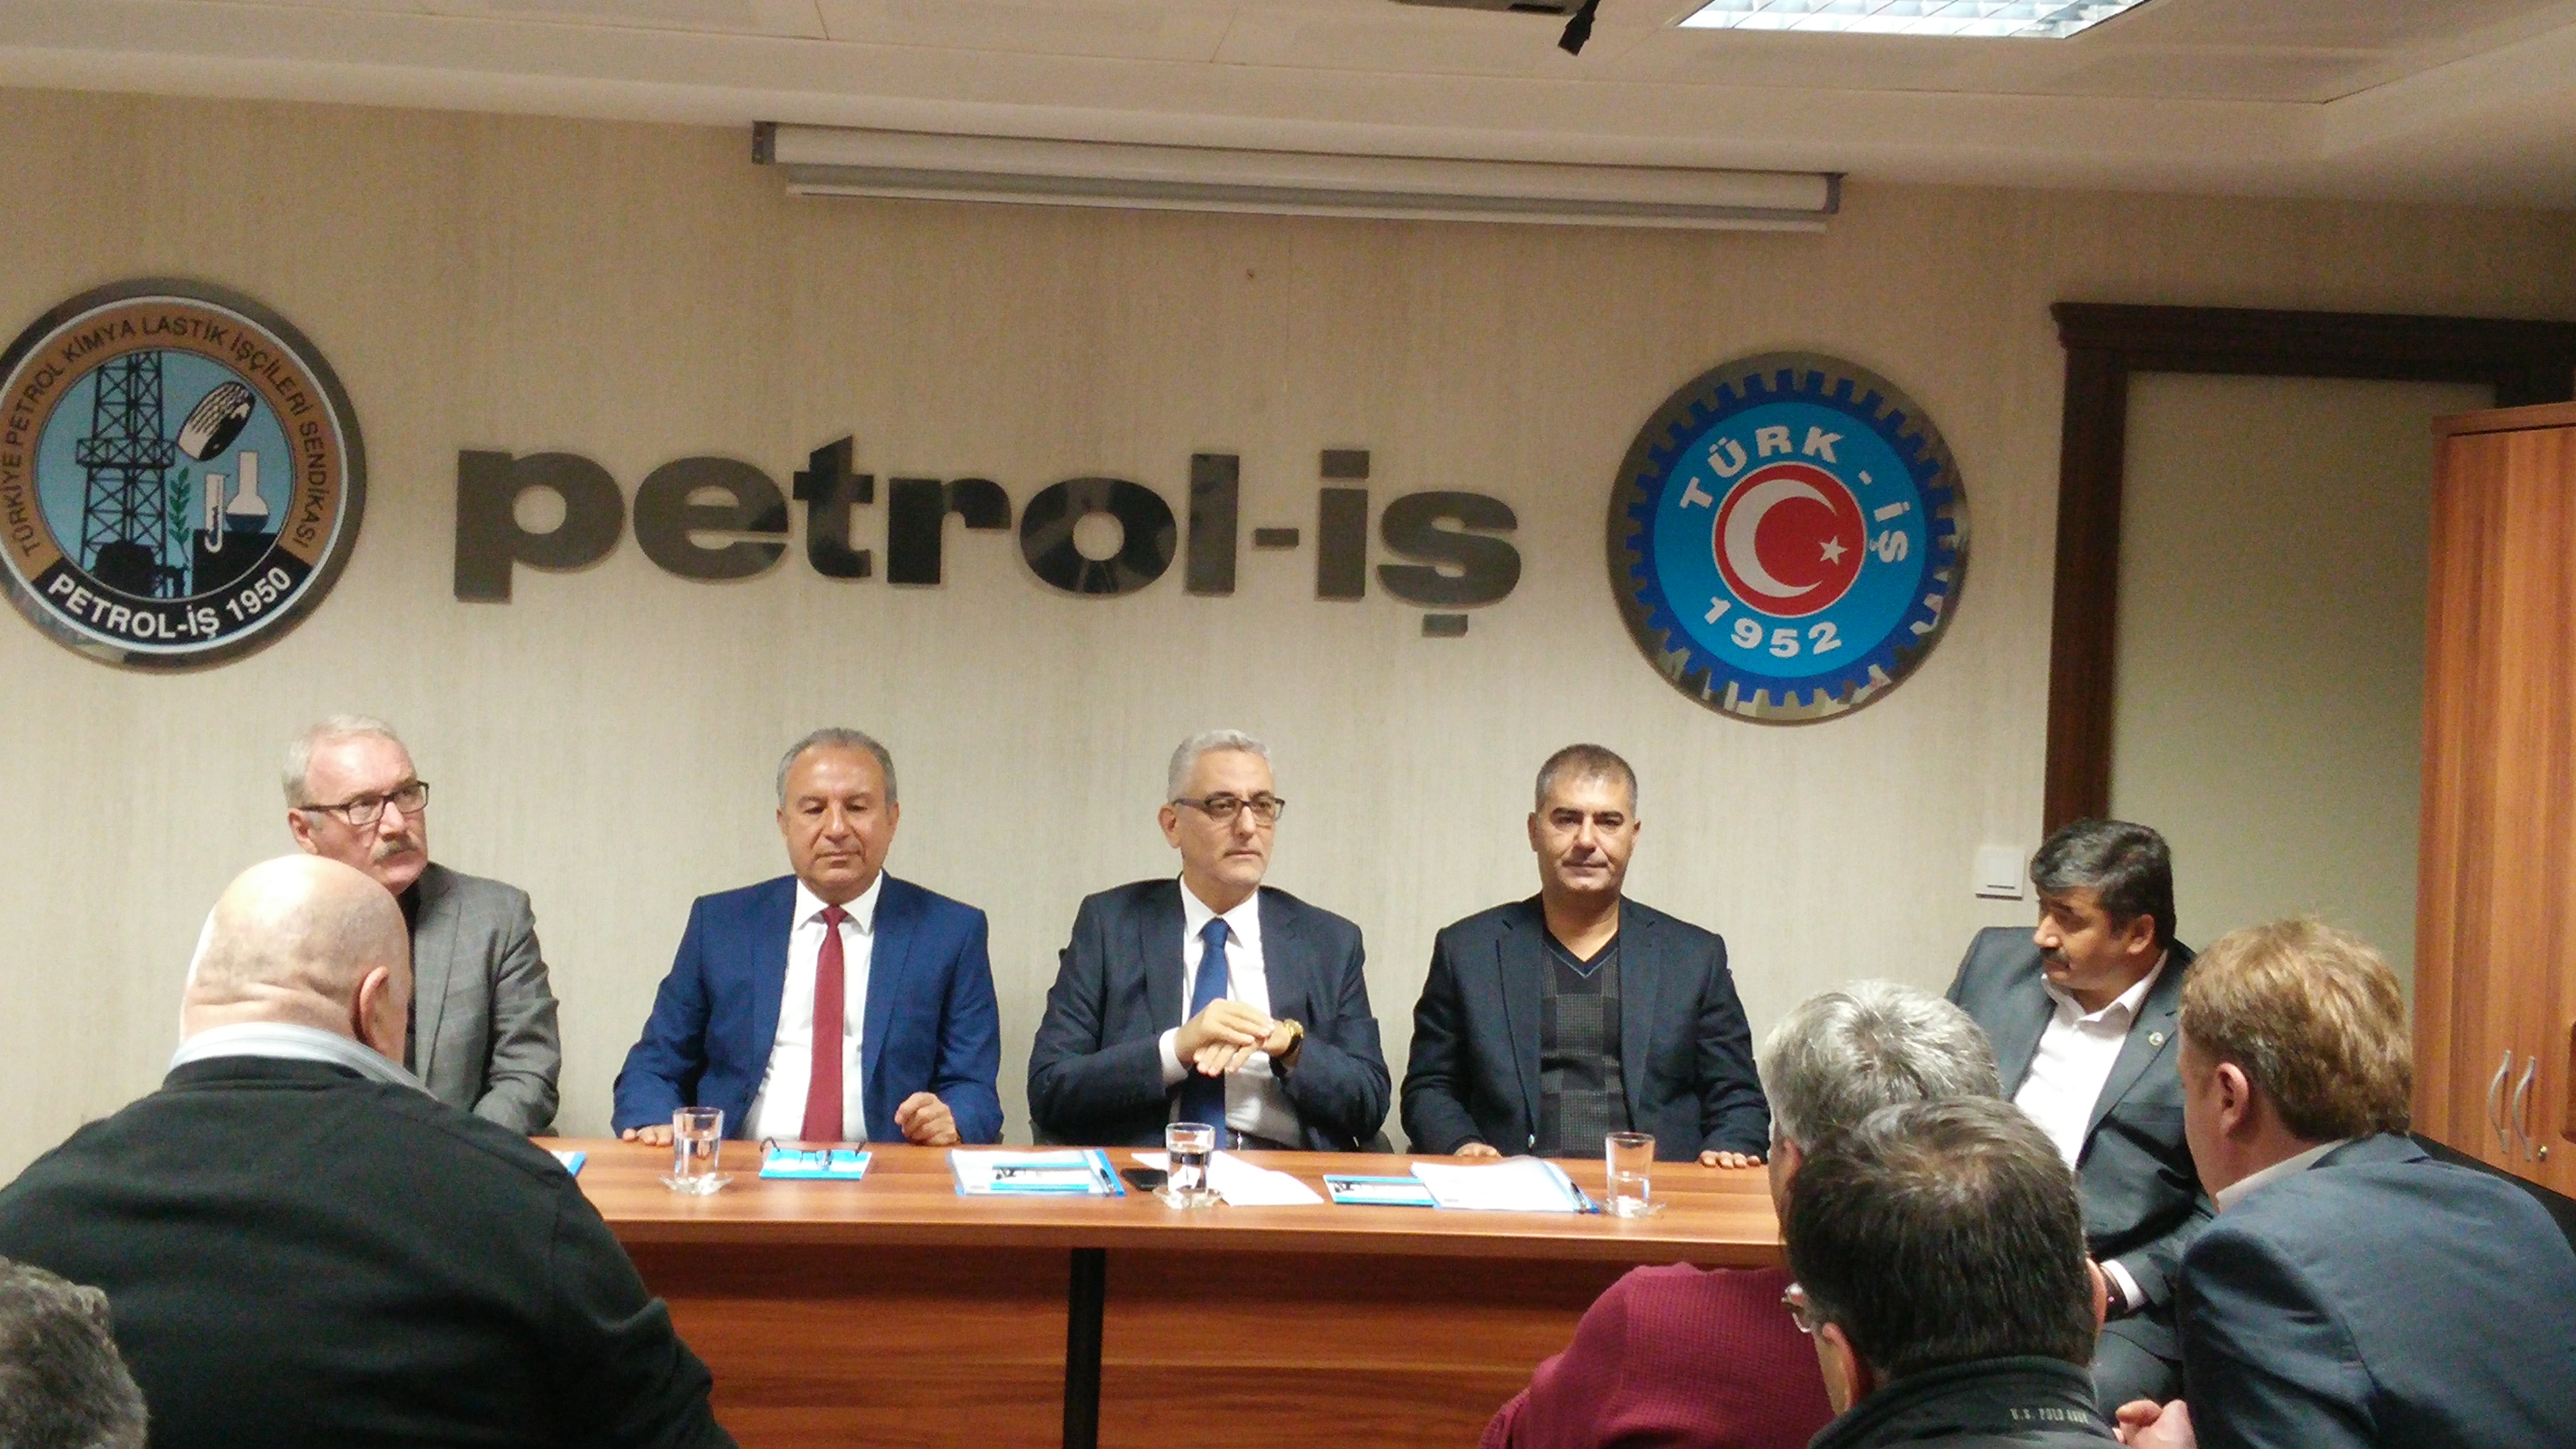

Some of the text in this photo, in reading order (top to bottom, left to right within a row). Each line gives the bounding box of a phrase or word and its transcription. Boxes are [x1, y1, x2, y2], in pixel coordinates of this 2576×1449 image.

[2, 316, 330, 557] TÜRKİYE PETROL KİMYA LASTİK İŞÇİLERİ SENDİKASI
[48, 566, 292, 642] PETROL-İŞ 1950
[453, 434, 1523, 637] petrol-iş
[1704, 596, 1842, 658] 1952
